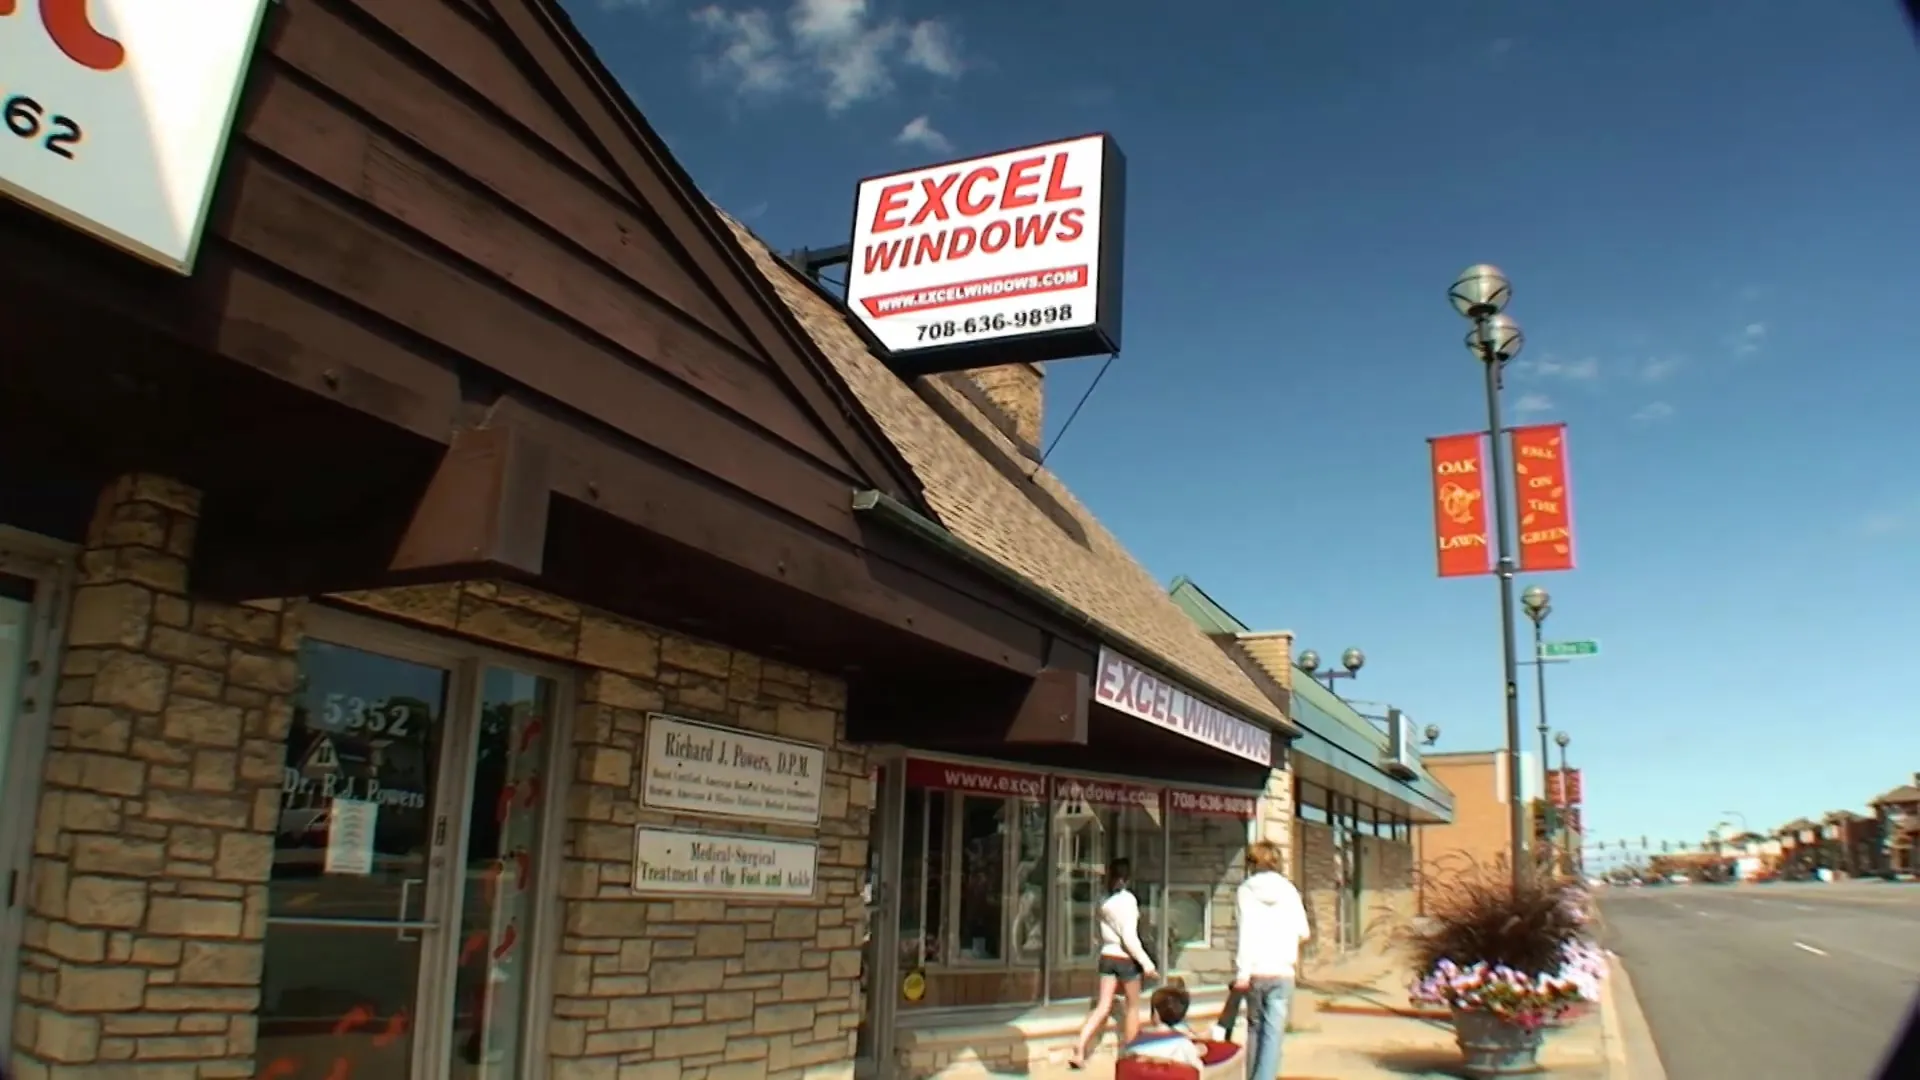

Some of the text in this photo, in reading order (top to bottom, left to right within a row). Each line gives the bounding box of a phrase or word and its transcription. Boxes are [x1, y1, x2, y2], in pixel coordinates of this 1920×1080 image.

[3, 95, 82, 160] 62
[871, 152, 1083, 234] EXCEL
[864, 207, 1085, 275] WINDOWS
[877, 270, 1078, 312] WWW.EXCELWINDOWS.COM
[917, 304, 1072, 341] 708-636-9898
[1437, 458, 1477, 475] OAK
[1440, 533, 1487, 550] LAWN
[324, 694, 410, 736] 5352
[1098, 660, 1271, 761] EXCEL WINDOWS
[665, 732, 714, 762] Richard
[717, 741, 728, 766] J.
[367, 779, 424, 808] Powers
[944, 769, 1045, 795] www.excel
[640, 861, 698, 882] Treatment
